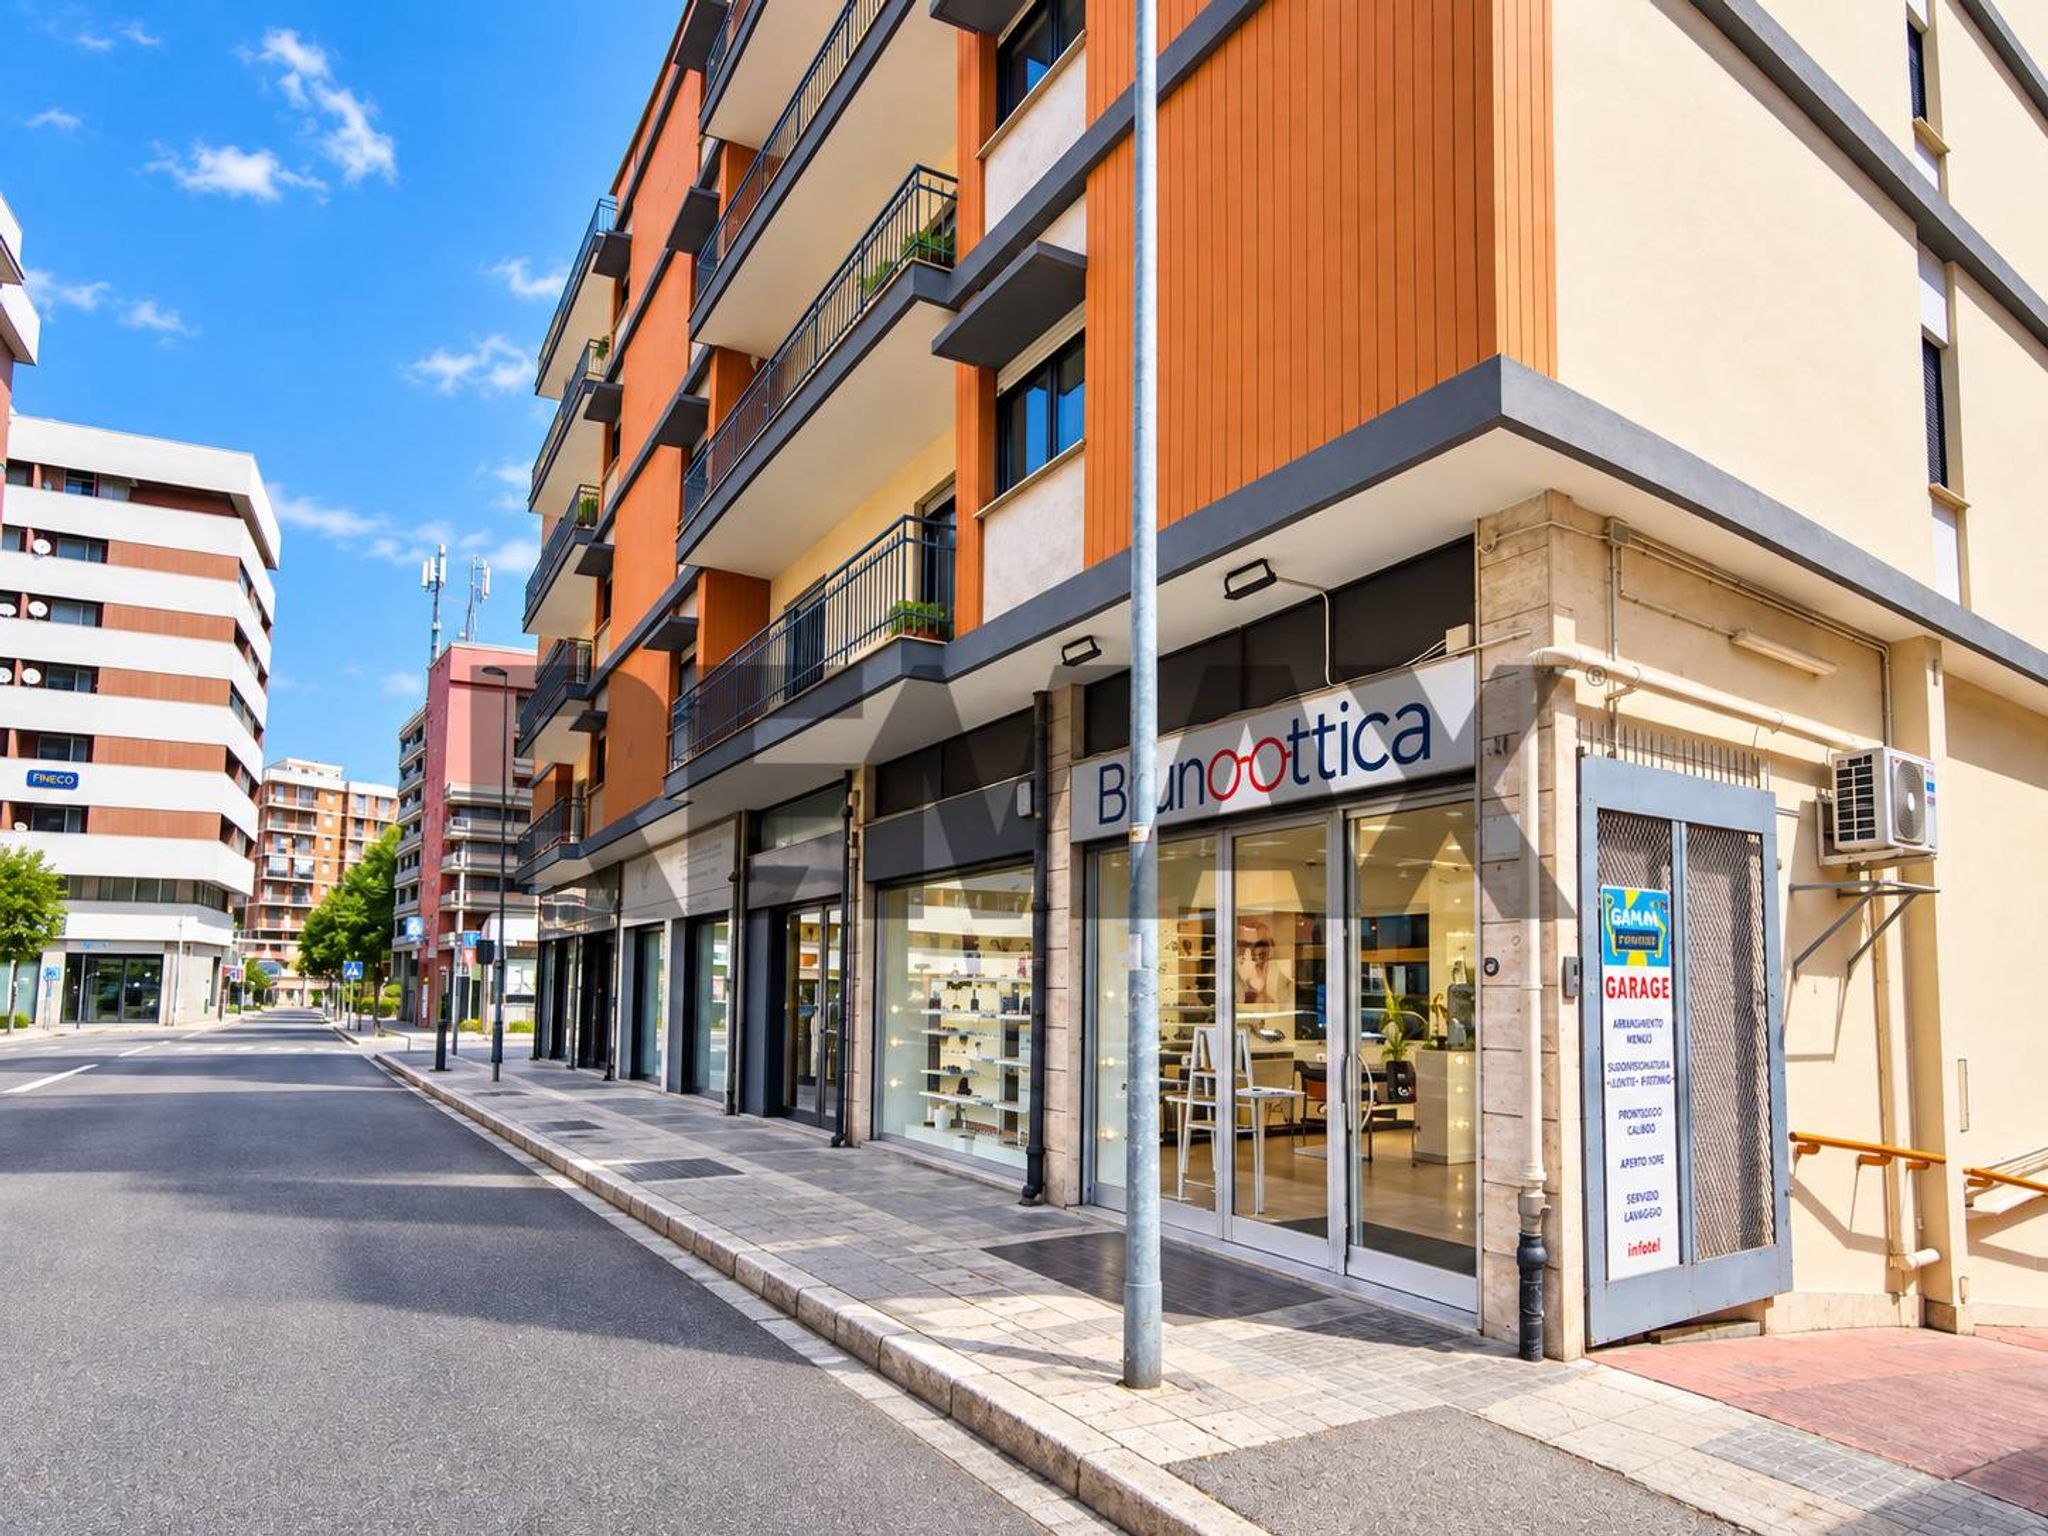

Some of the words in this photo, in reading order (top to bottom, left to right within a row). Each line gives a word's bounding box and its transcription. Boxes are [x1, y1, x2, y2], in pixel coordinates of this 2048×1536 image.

[1098, 700, 1432, 825] Bunoottica
[32, 773, 75, 785] FINECO
[1605, 976, 1670, 998] GARAGE
